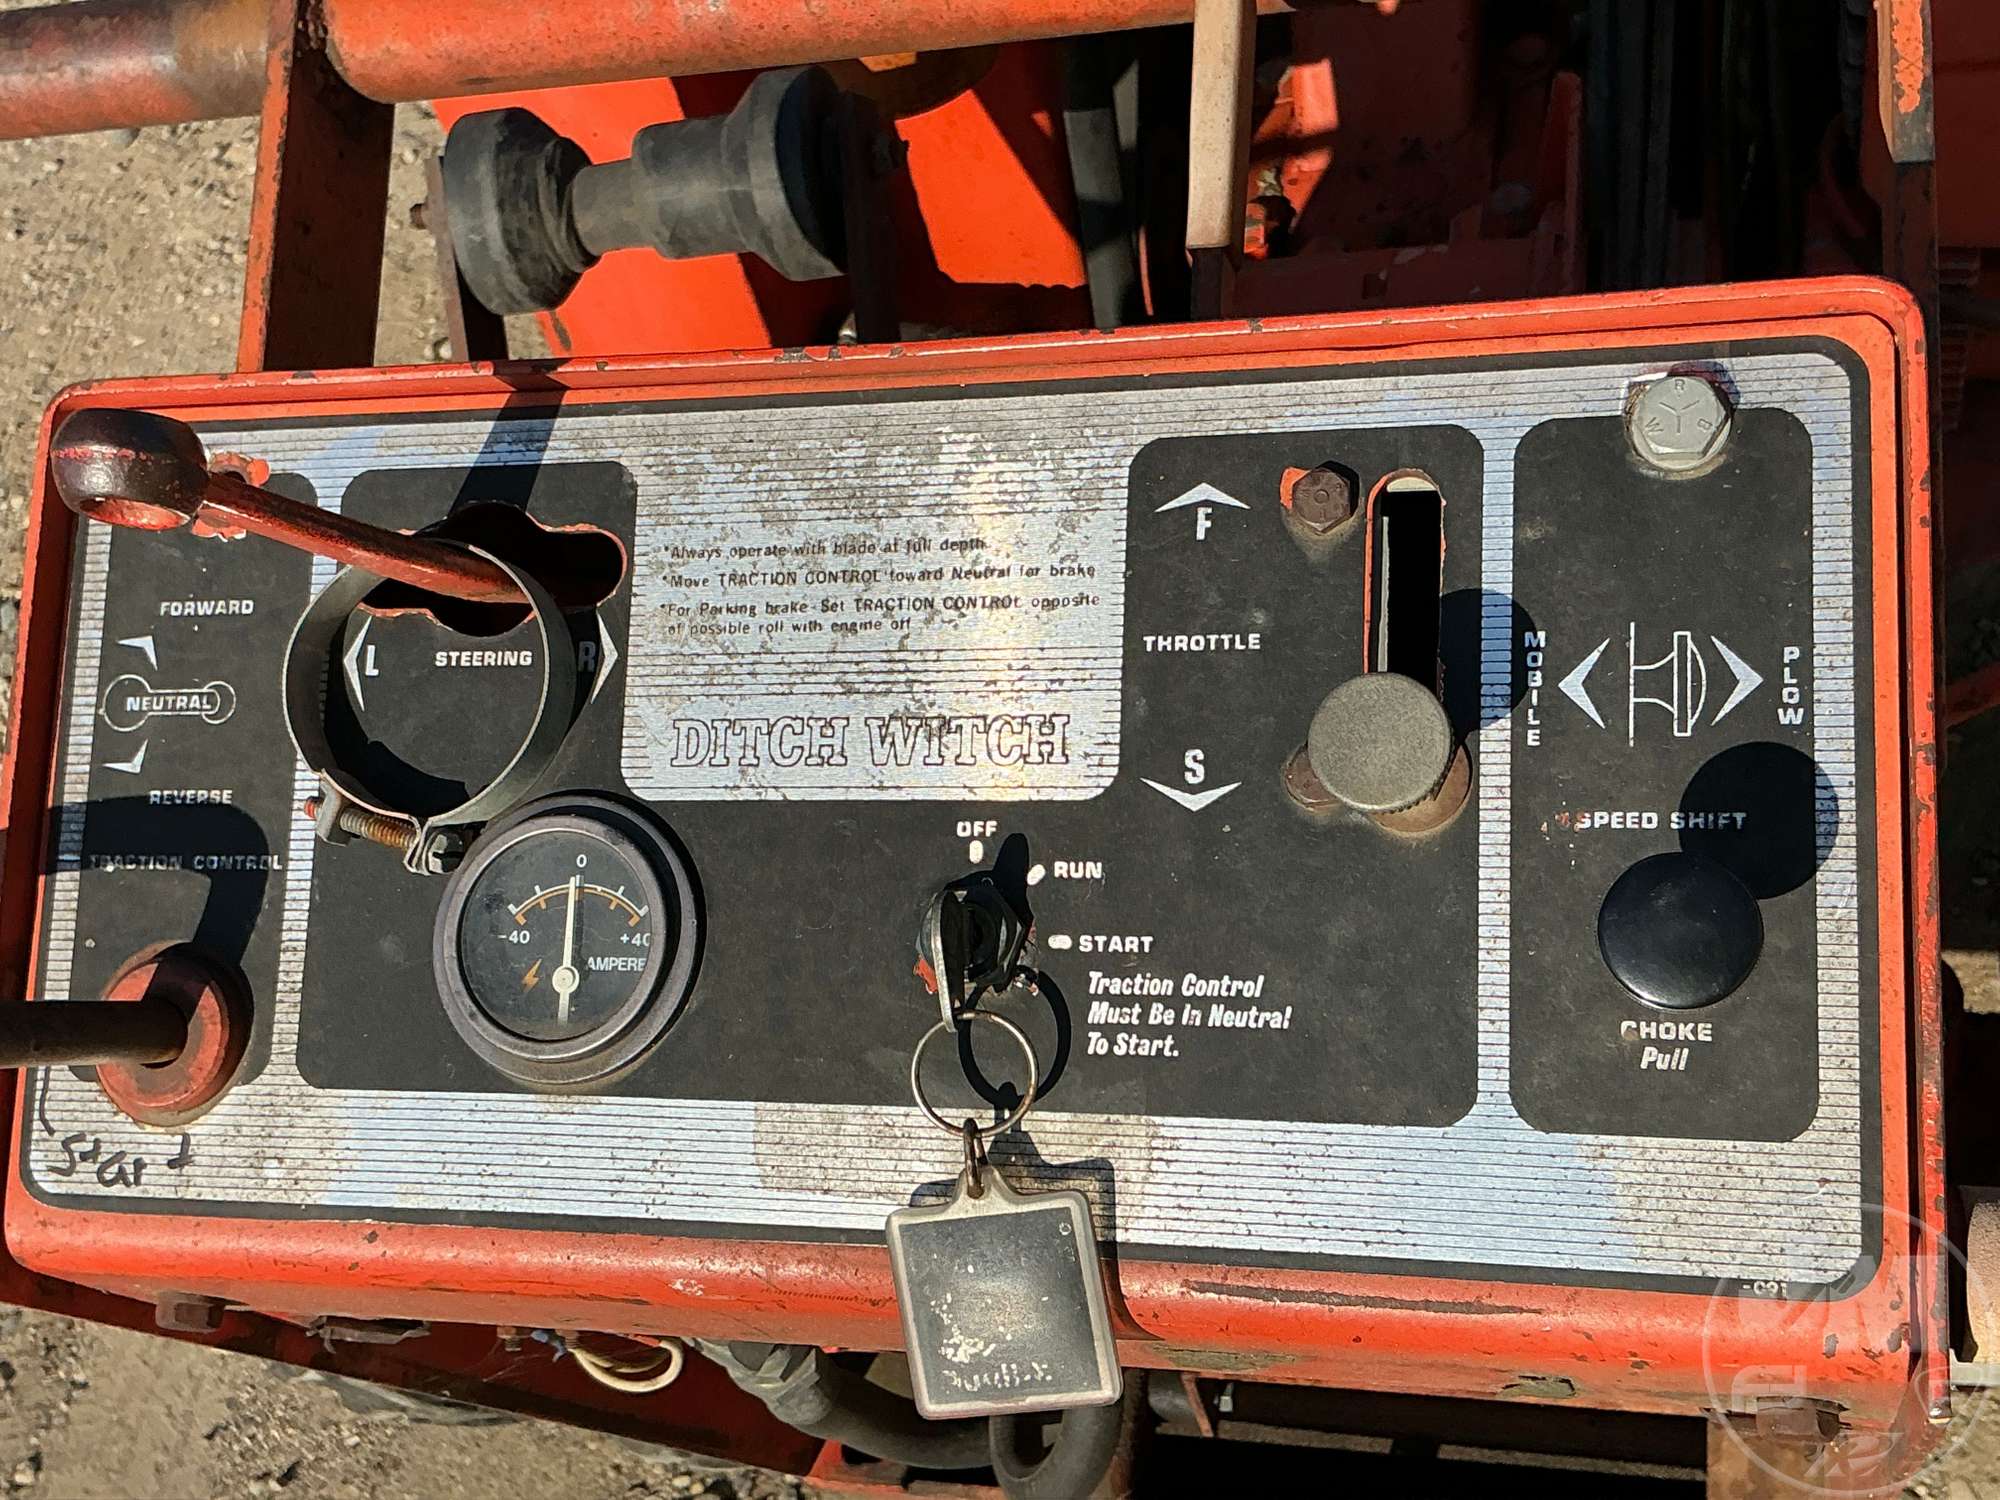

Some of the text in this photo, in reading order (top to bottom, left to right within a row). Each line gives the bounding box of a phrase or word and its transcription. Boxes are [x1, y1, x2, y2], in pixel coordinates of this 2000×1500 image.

[1196, 506, 1213, 541] F
[729, 543, 786, 560] operate
[794, 540, 826, 556] with
[832, 540, 876, 556] blade
[883, 536, 898, 553] at
[718, 571, 798, 589] TRACTION
[804, 568, 882, 587] CONTROL
[889, 567, 944, 582] toward
[950, 565, 1011, 581] Neutral
[1019, 565, 1041, 579] for
[159, 599, 255, 617] FORWARD
[699, 601, 758, 619] Parking
[820, 598, 845, 614] Set
[854, 596, 935, 613] TRACTION
[942, 594, 1021, 611] CONTROL
[1031, 592, 1101, 612] opposite
[689, 620, 751, 638] possible
[758, 620, 785, 634] roll
[791, 619, 823, 633] with
[830, 618, 883, 635] engine
[1142, 632, 1262, 652] THROTTLE
[364, 644, 380, 676] L
[434, 649, 534, 669] STEERING
[577, 640, 596, 673] R
[1523, 629, 1547, 748] MOBILE
[1776, 645, 1805, 726] PLOW
[125, 693, 213, 713] NEUTRAL
[670, 712, 1071, 769] DITCH WITCH
[1183, 748, 1206, 785] S
[149, 789, 234, 806] REVERSE
[956, 820, 999, 838] OFF
[1575, 810, 1749, 831] SPEED SHIFT
[88, 853, 284, 872] TRACTION CONTROL
[575, 853, 588, 869] 0
[1053, 861, 1103, 879] RUN
[497, 929, 531, 945] -40
[1078, 935, 1155, 954] START
[1087, 971, 1265, 999] Traction Control
[1087, 1002, 1293, 1030] Must Be In Neutral
[1619, 1019, 1714, 1042] CHOKE
[1087, 1031, 1181, 1058] To Start.
[1639, 1045, 1690, 1072] Pull
[46, 1131, 197, 1188] Start
